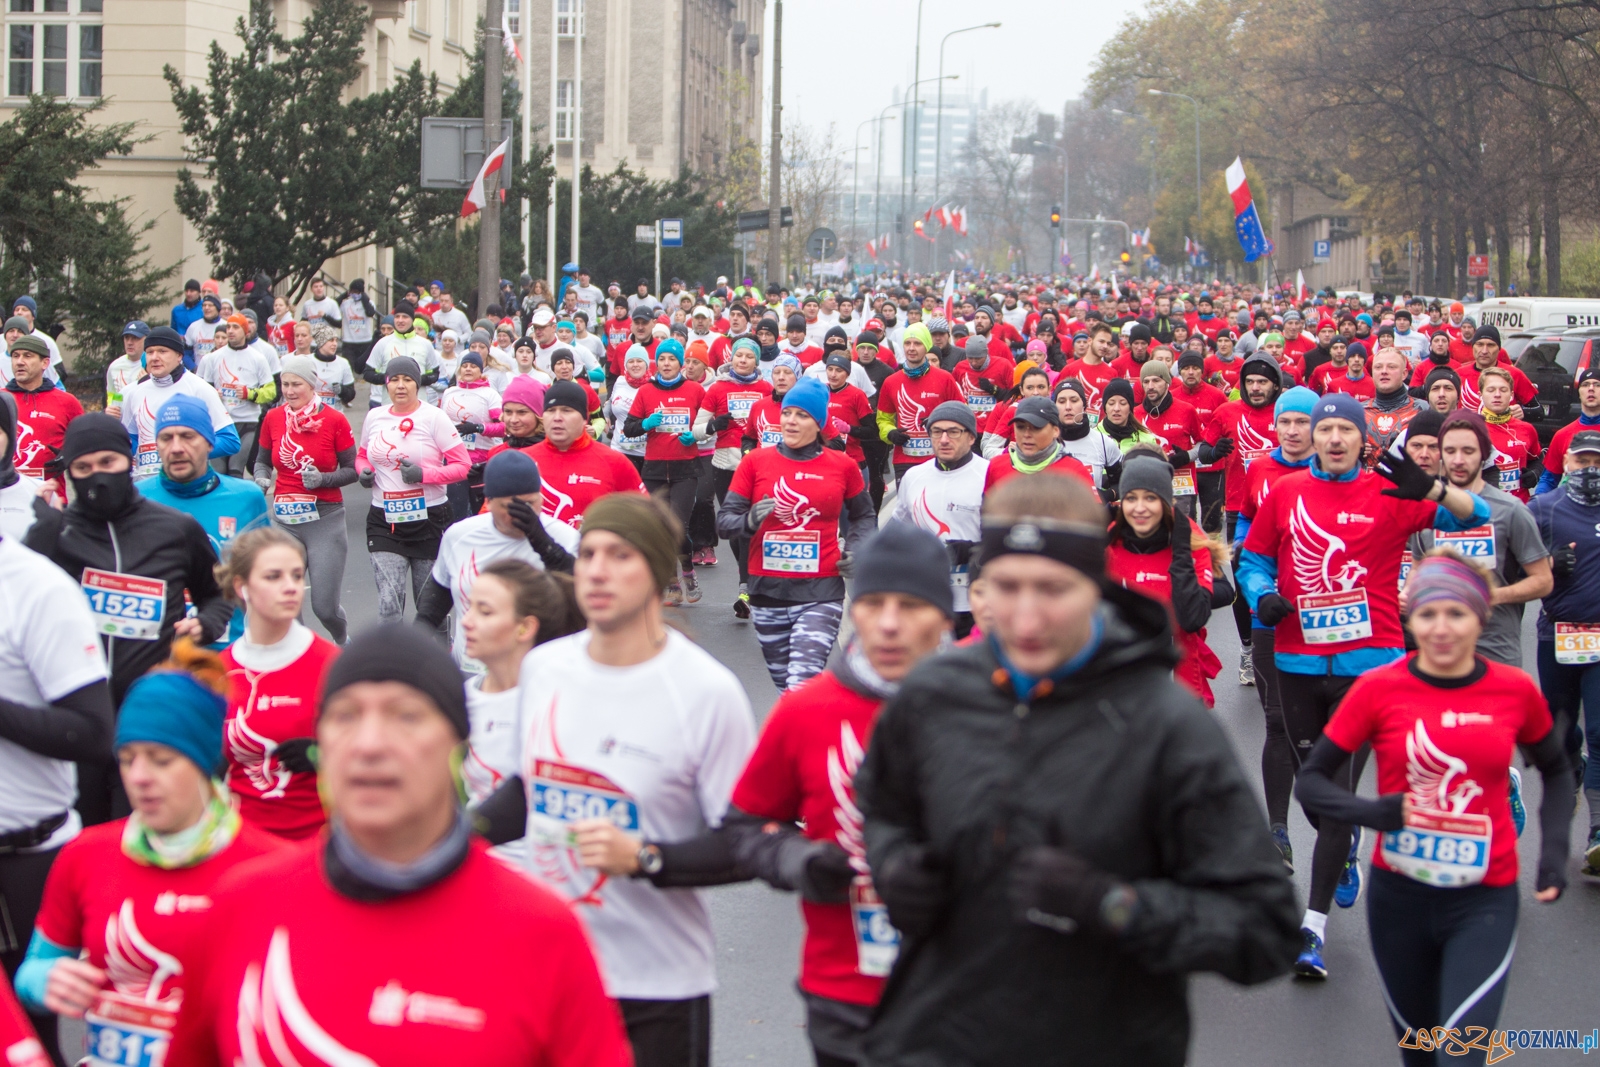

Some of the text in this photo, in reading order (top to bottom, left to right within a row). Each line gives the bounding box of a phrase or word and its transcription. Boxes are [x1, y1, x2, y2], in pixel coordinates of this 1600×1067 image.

[1317, 241, 1328, 256] P
[280, 503, 311, 515] 3643
[388, 499, 420, 512] 6561
[770, 544, 813, 558] 2945
[91, 591, 156, 620] 1525
[1308, 606, 1362, 628] 7763
[1564, 635, 1600, 650] 613
[544, 788, 631, 828] 9504
[1397, 831, 1478, 865] 9189
